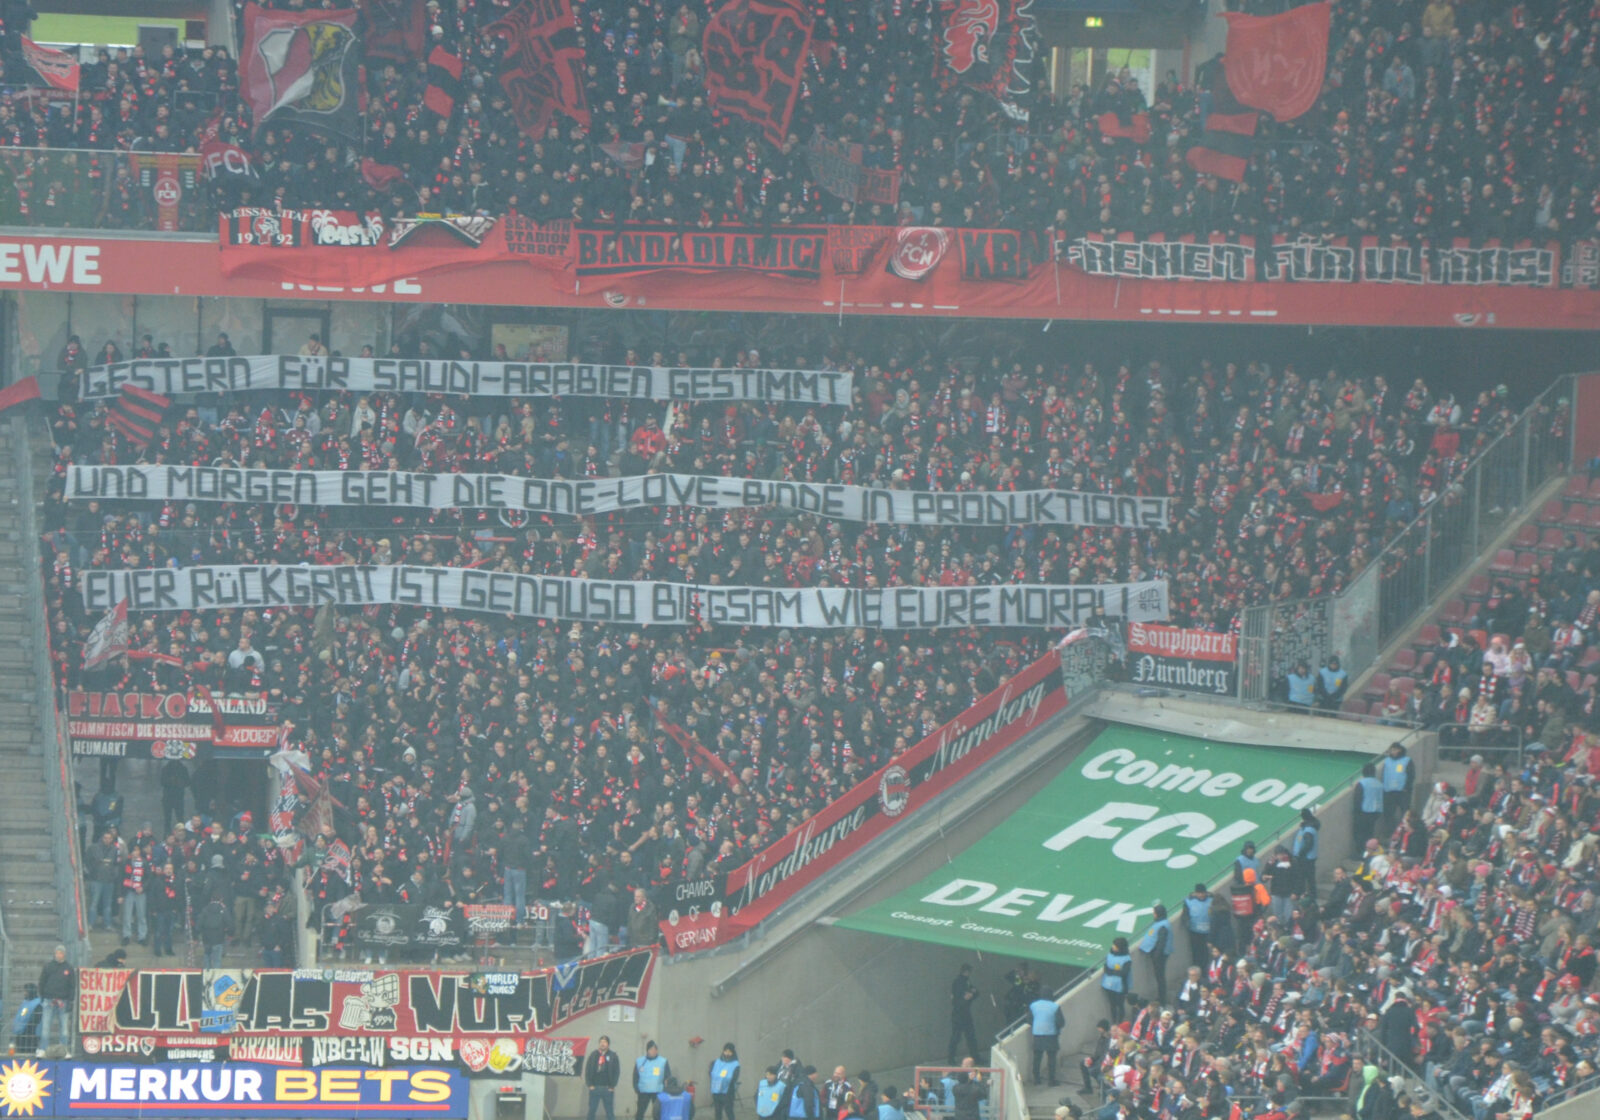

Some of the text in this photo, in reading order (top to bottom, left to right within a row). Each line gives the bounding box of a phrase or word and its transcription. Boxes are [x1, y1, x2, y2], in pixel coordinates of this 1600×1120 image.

[237, 232, 294, 245] 19 92
[504, 230, 571, 243] STADION
[507, 242, 567, 256] VERBOT
[578, 232, 688, 266] BANDA
[731, 235, 825, 270] AMICI
[900, 244, 935, 266] FCN
[1055, 237, 1255, 281] FREIHEIT
[1264, 235, 1355, 284] FÜR
[1361, 244, 1555, 287] ULTRAS!
[83, 356, 842, 401] GESTERN FÜR SAUDI-ARABIEN GESTIMMT
[74, 467, 147, 497] UND
[167, 467, 317, 503] MORGEN
[341, 471, 437, 506] GEHT
[453, 474, 506, 507] DIE
[523, 474, 844, 516] ONE-LOVE-BINDE
[862, 489, 895, 522] IN
[87, 567, 178, 610] EUER
[189, 565, 378, 605] RÜCKGRAT
[390, 566, 448, 605] IST
[460, 572, 637, 622] GENAUSO
[652, 583, 802, 625] BIEGSAM
[816, 586, 883, 628] WIE
[895, 588, 992, 627] EURE
[1131, 654, 1230, 694] Nürnberg
[68, 691, 188, 720] FIASKO
[69, 721, 134, 738] STAMMTISCH
[136, 723, 153, 739] DIE
[154, 724, 212, 739] BESESSENEN
[73, 740, 128, 757] NEUMARKT
[924, 680, 1047, 783] Nürnberg
[1081, 747, 1244, 797] Come
[1042, 800, 1260, 869] FC!
[732, 804, 866, 916] Nordkurve
[675, 880, 716, 901] CHAMPS
[920, 877, 1156, 934] DEVK
[890, 909, 1105, 951] Gesagt. Getan. Geholfen.
[101, 1034, 140, 1052] RSR
[390, 1037, 454, 1062] SGN
[69, 1068, 452, 1103] MERKUR BETS
